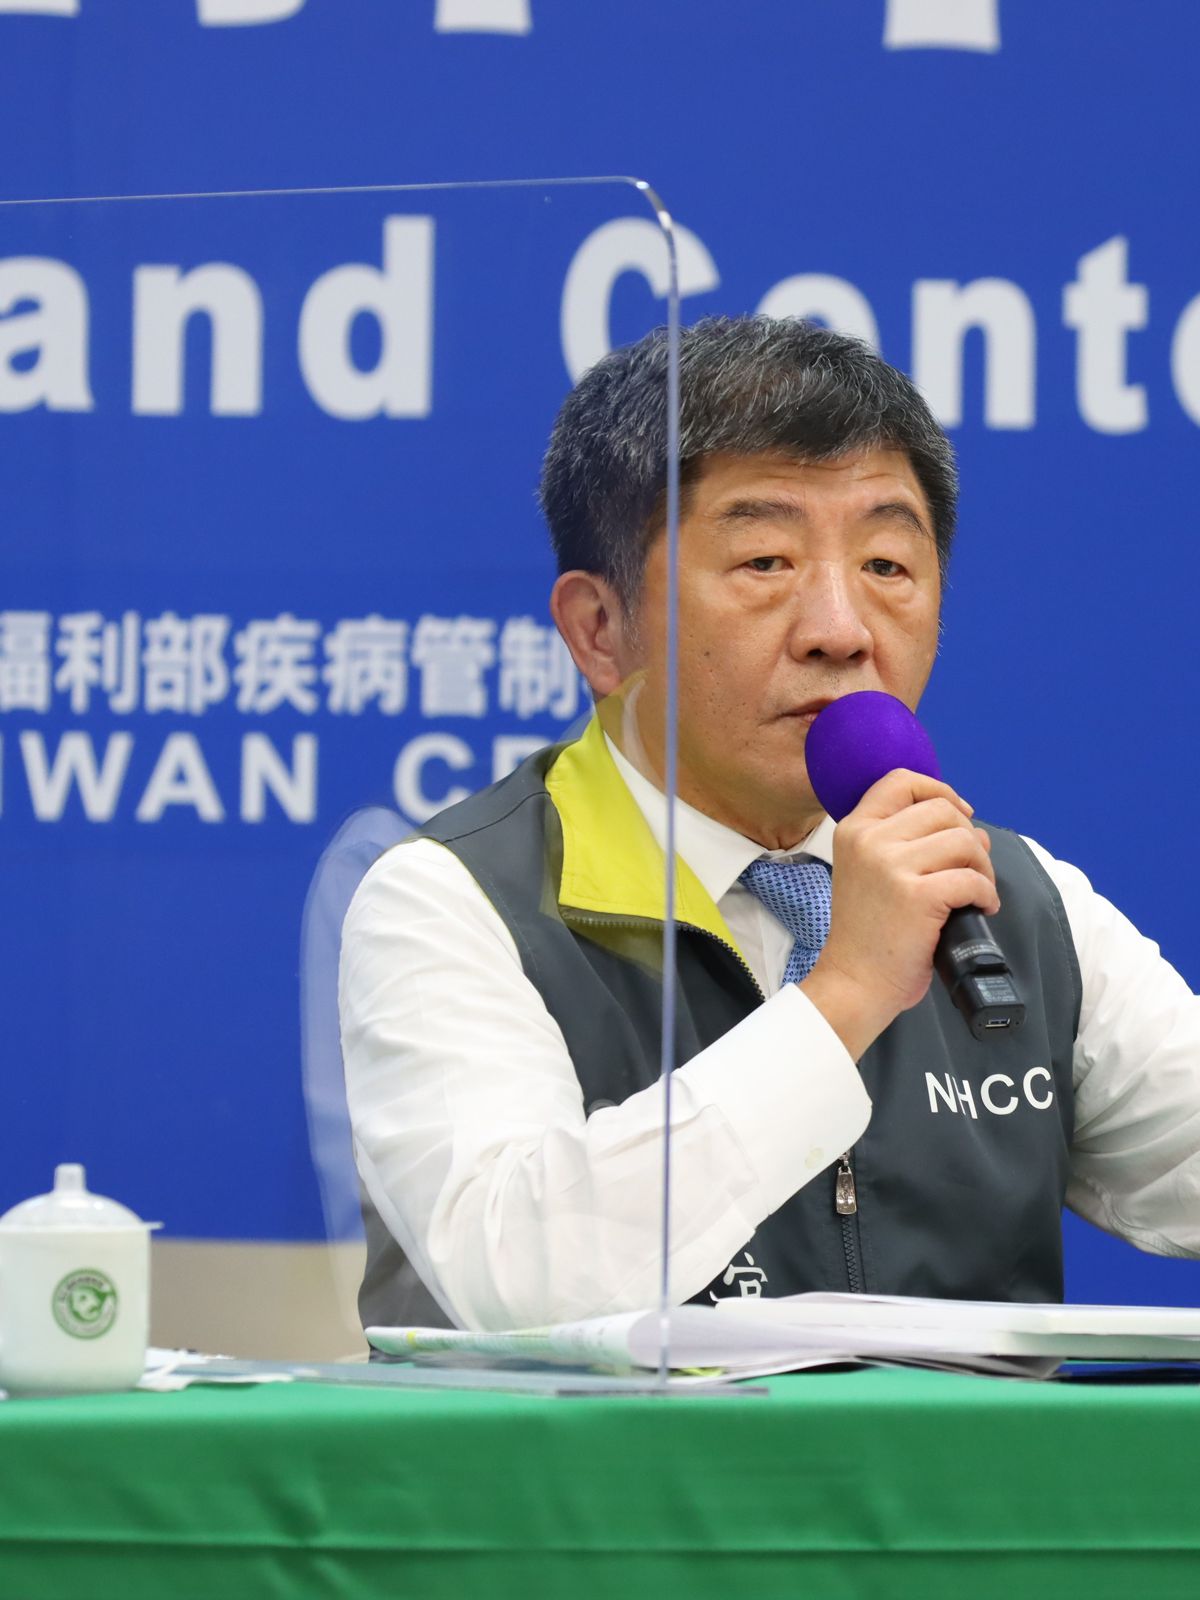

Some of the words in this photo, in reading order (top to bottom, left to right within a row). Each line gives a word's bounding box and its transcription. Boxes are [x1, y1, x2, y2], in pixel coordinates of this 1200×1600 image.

[0, 610, 593, 721] 福利部疾病管制
[0, 729, 318, 824] WAN
[924, 1066, 1054, 1119] NHCC
